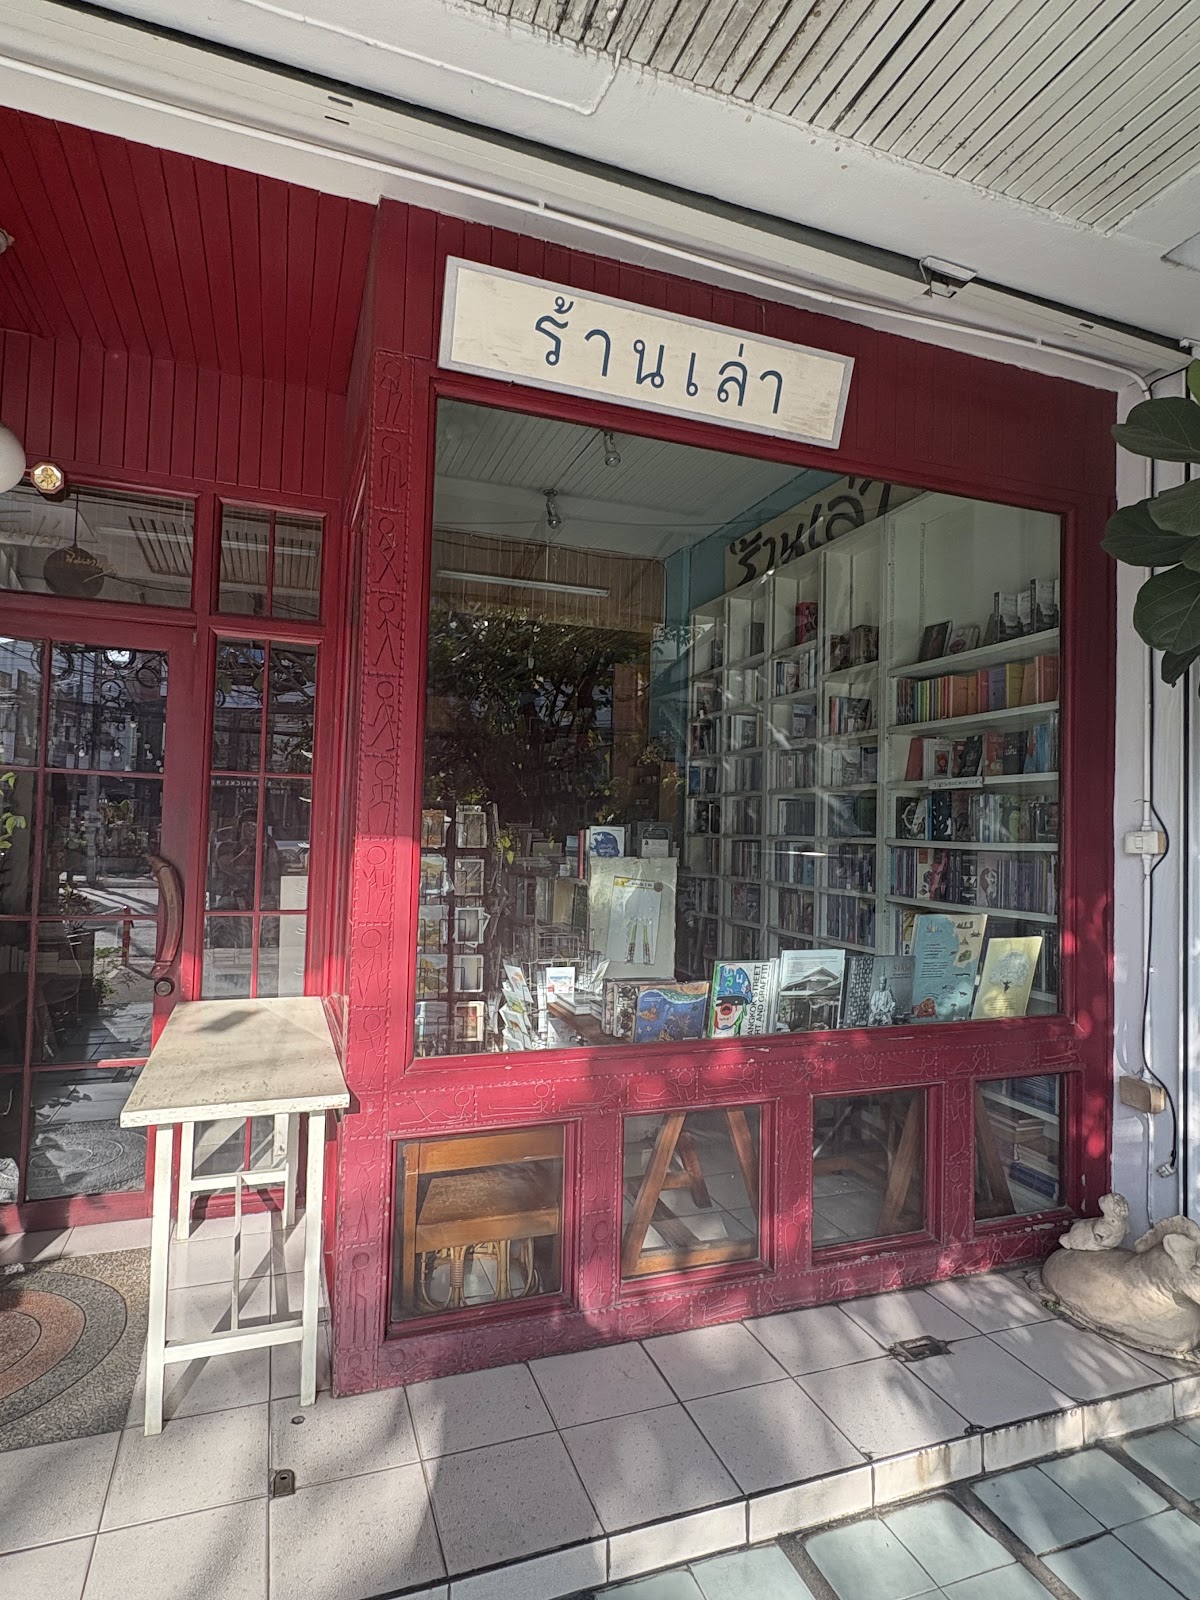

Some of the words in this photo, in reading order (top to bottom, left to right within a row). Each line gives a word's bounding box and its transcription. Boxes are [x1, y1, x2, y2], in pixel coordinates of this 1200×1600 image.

[534, 296, 784, 414] ร้านเล่า
[753, 966, 761, 997] STREET
[893, 964, 912, 973] SIAM
